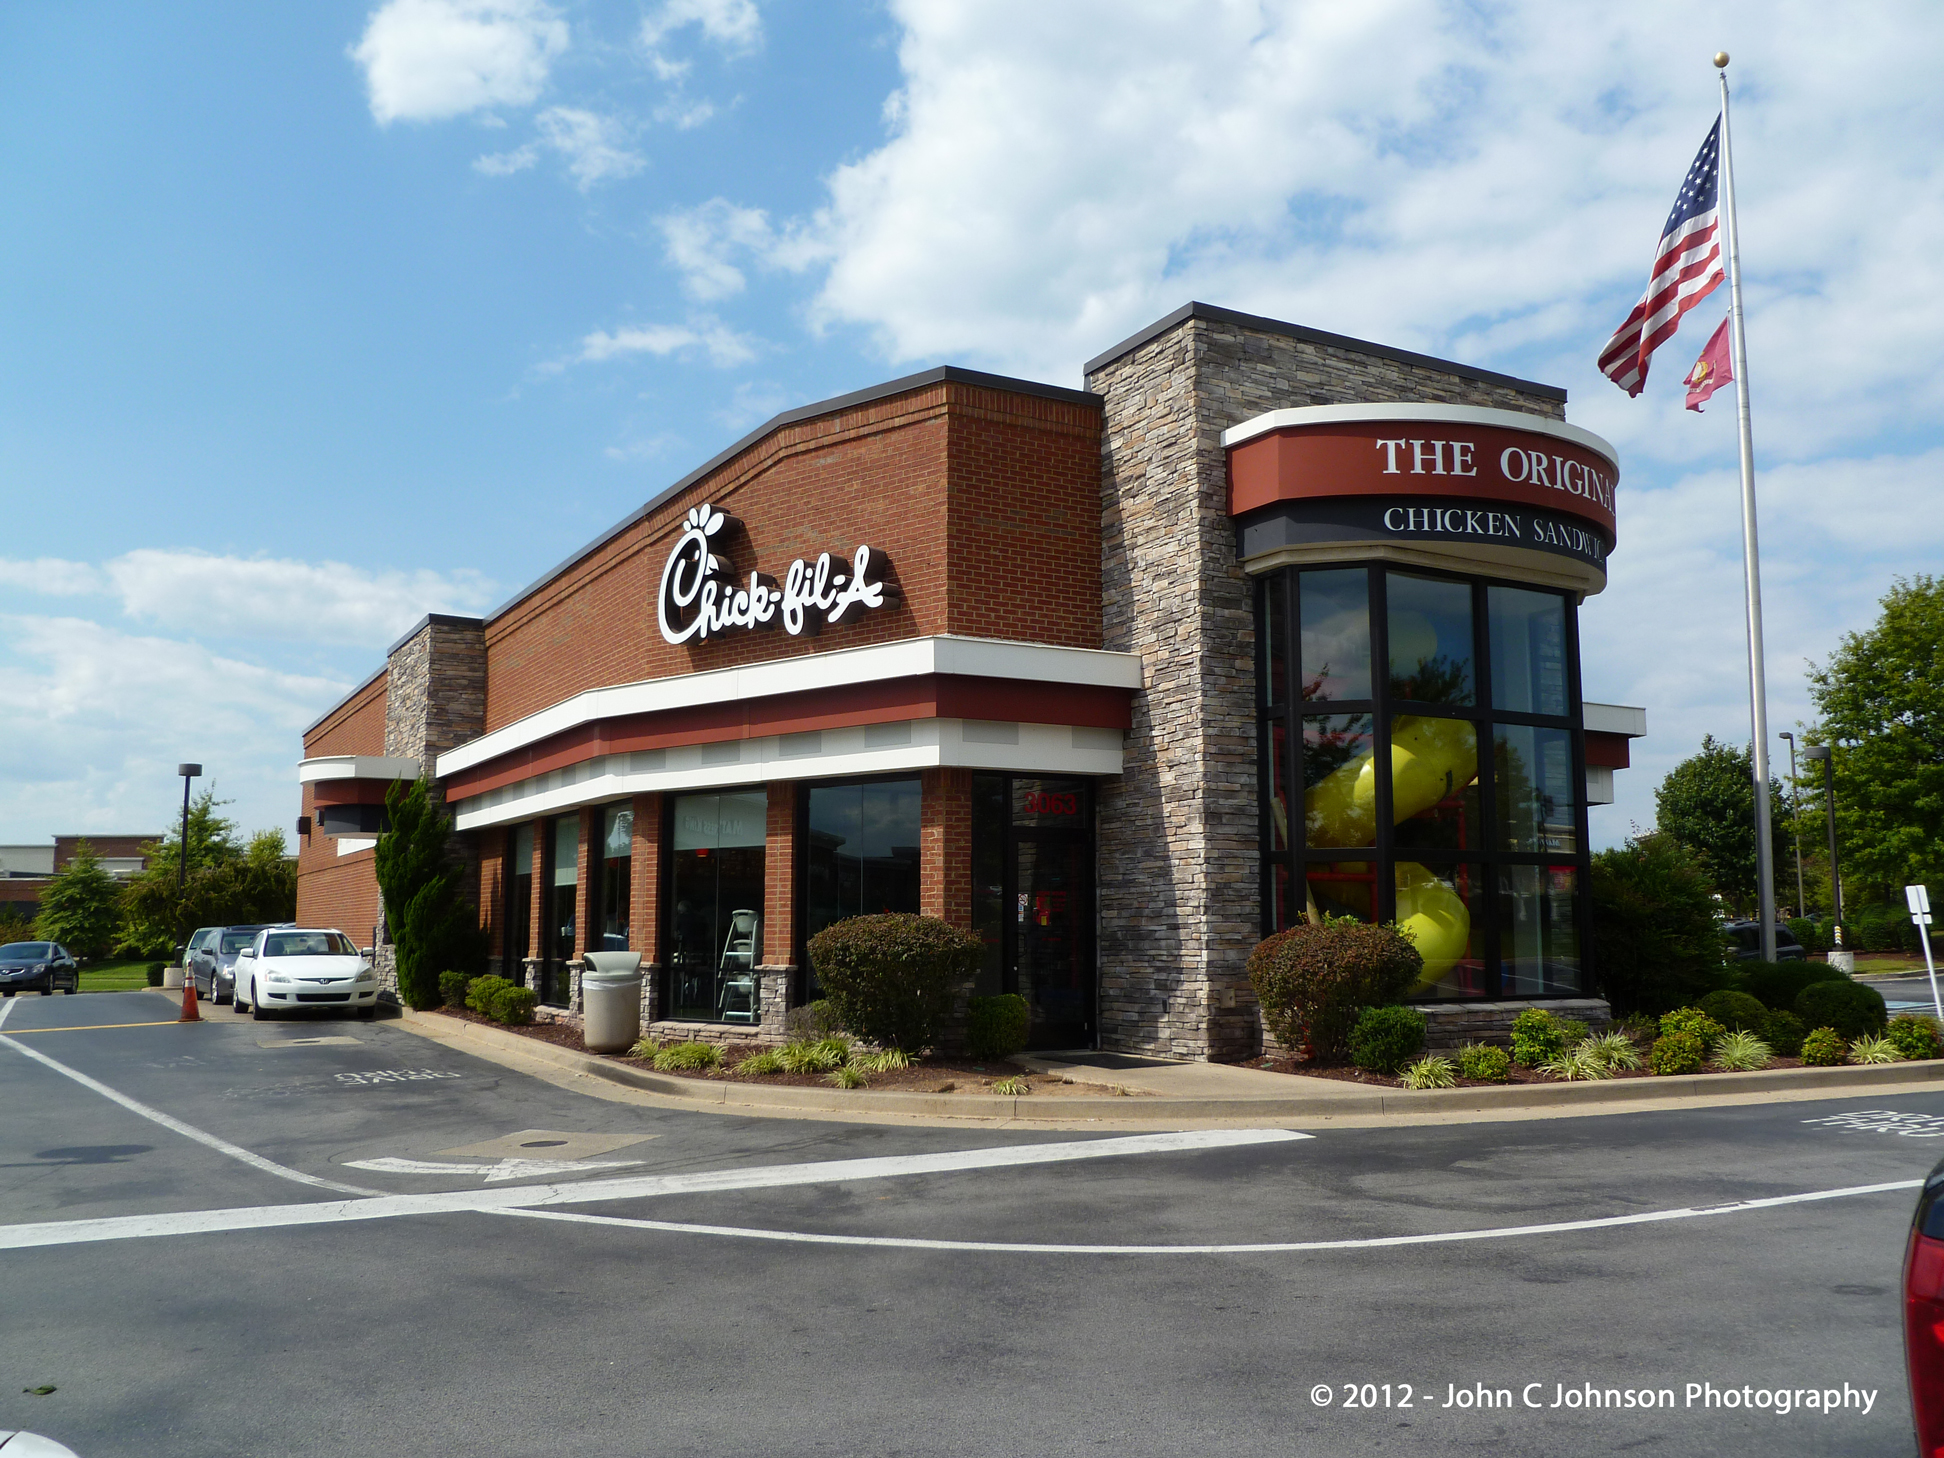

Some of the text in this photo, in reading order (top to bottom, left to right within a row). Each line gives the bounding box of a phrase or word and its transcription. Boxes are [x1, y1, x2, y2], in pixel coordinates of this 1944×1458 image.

[1375, 437, 1478, 477] THE
[1383, 507, 1605, 564] CHICKEN SANDWIC
[658, 503, 884, 646] Chick-fil-A
[1024, 792, 1076, 815] 3063
